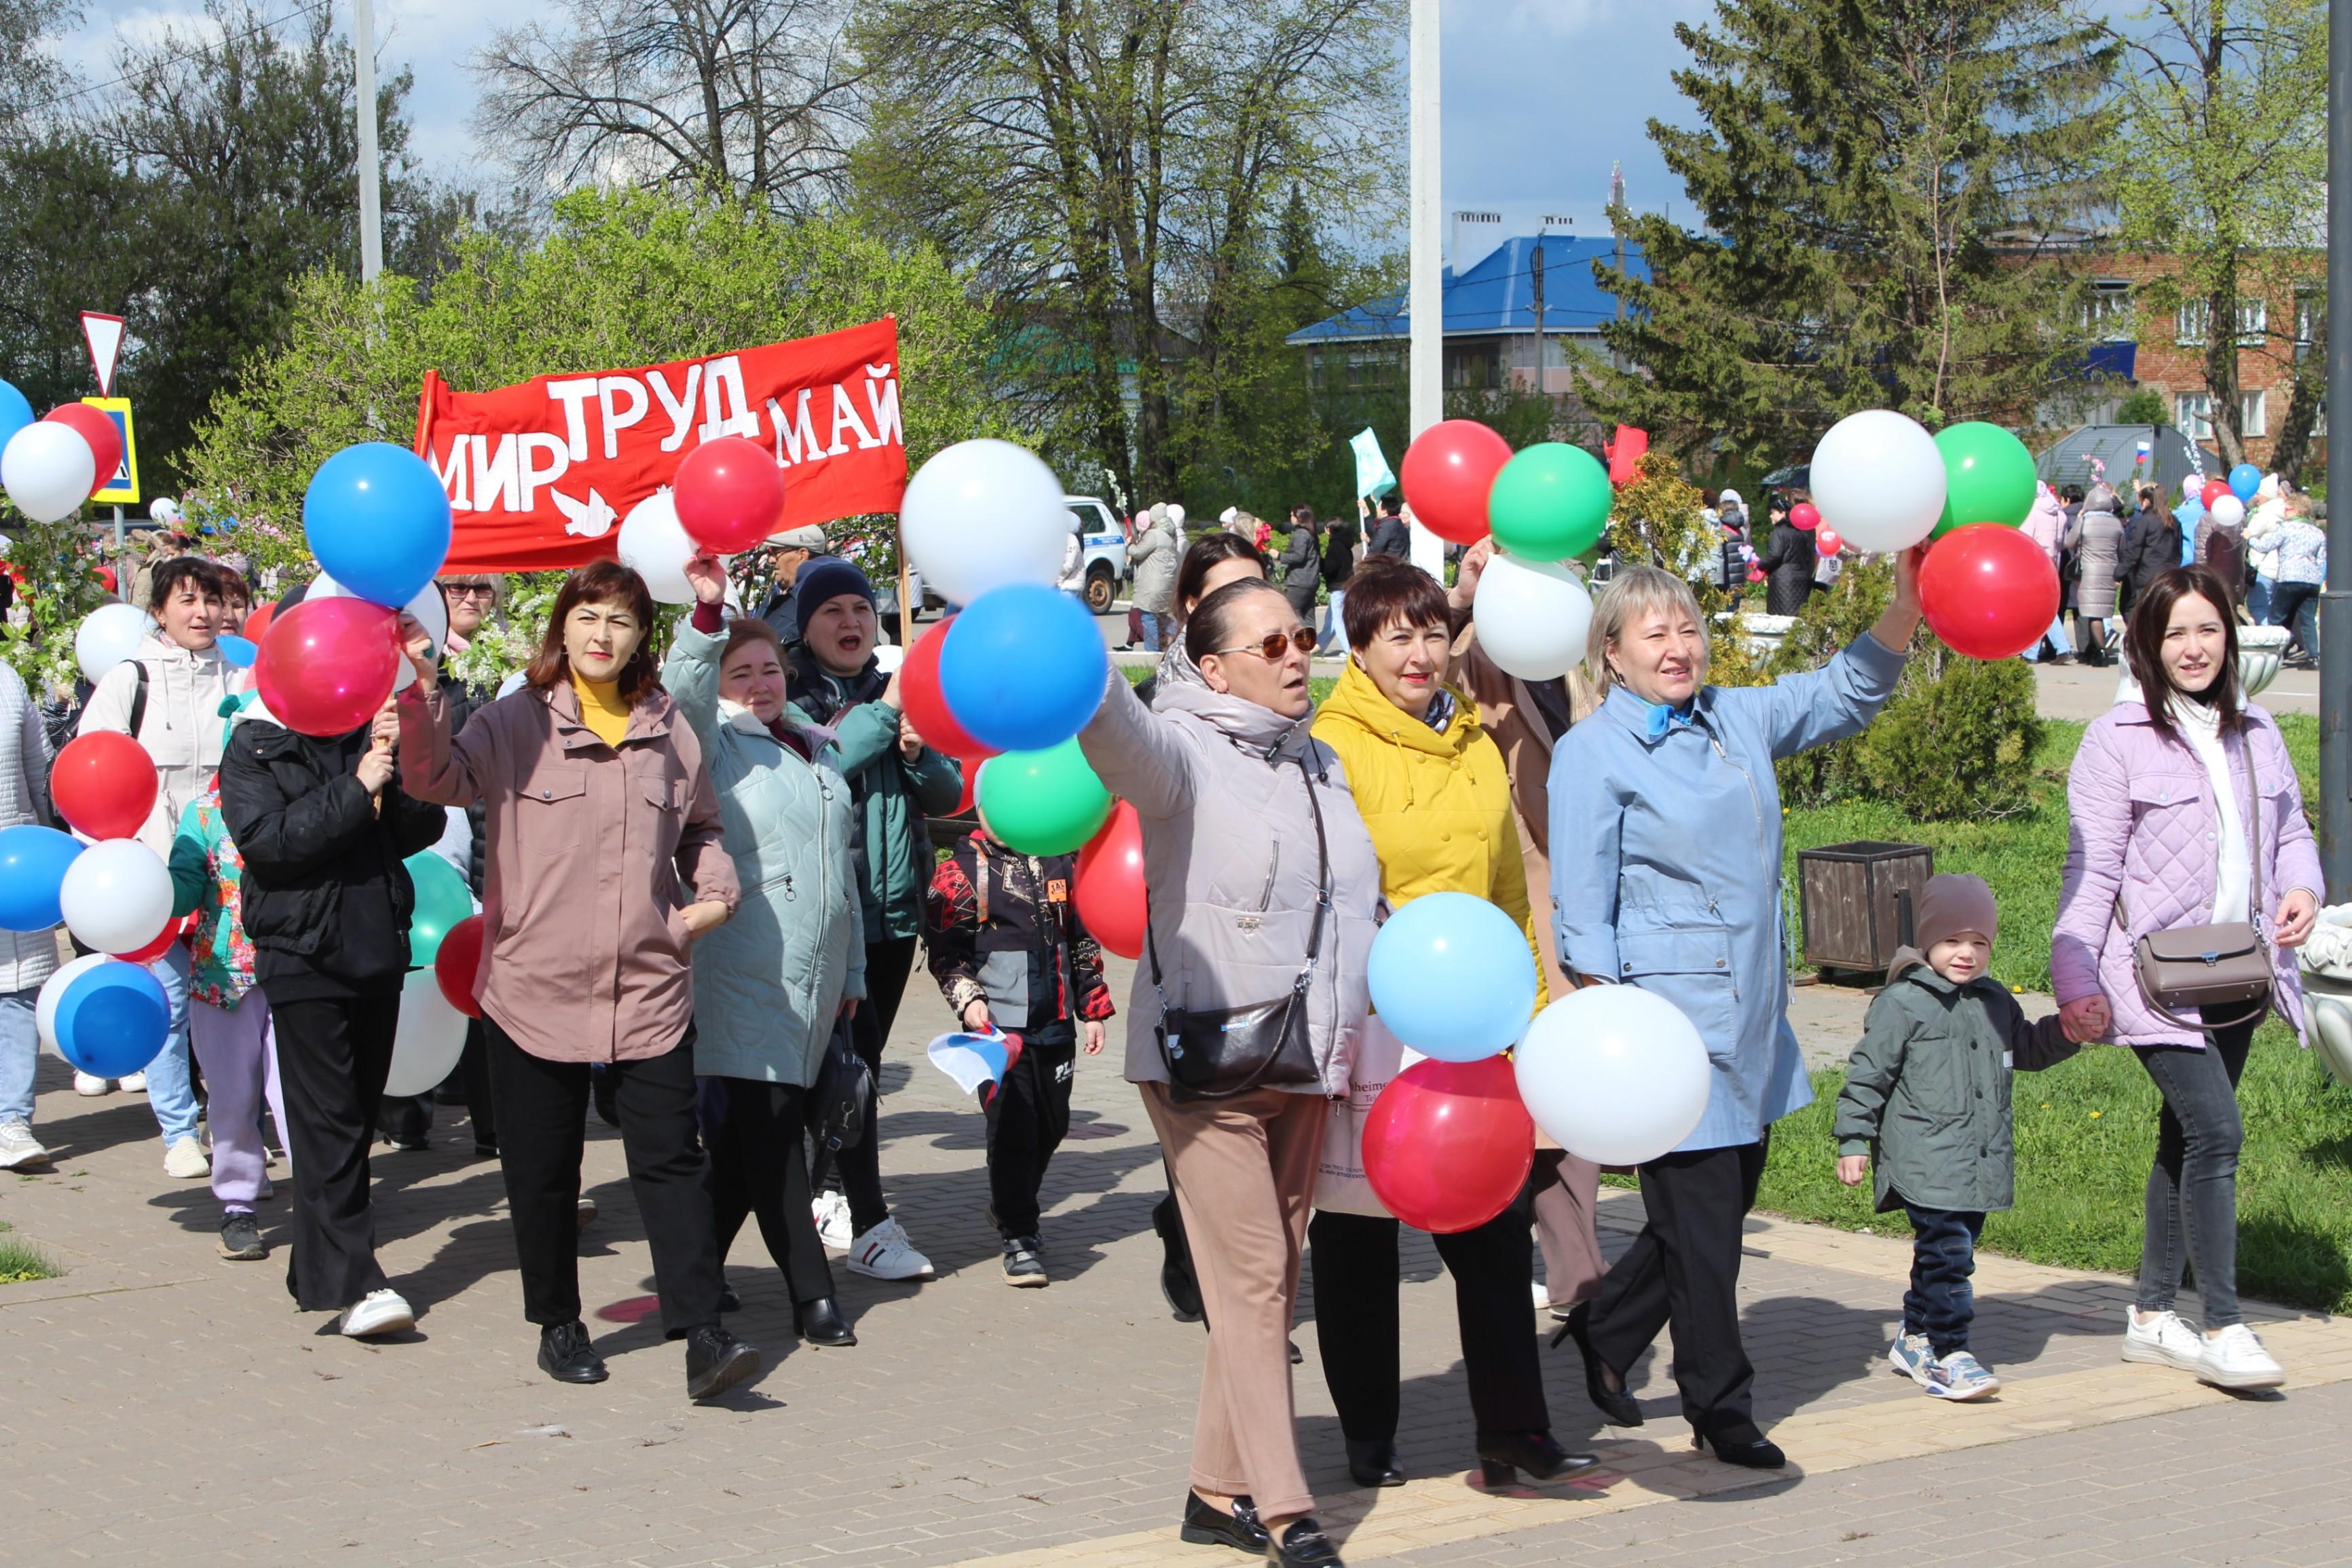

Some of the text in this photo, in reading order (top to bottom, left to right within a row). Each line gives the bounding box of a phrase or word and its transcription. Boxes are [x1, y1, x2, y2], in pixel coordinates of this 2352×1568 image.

[426, 355, 903, 512] МИР ТРУД МАЙ
